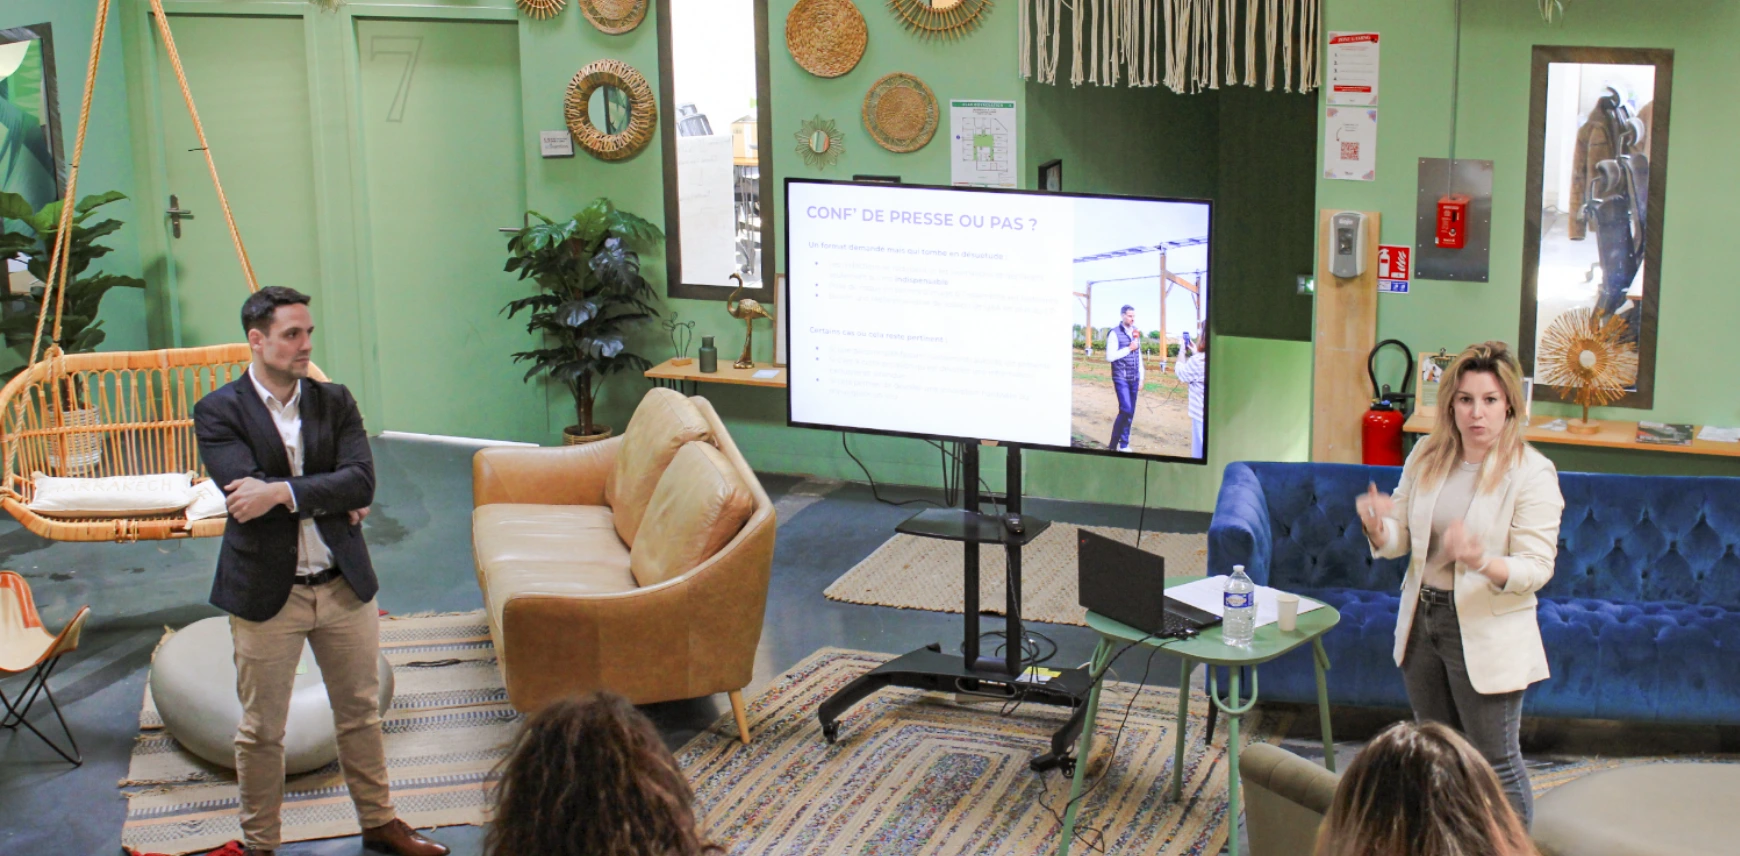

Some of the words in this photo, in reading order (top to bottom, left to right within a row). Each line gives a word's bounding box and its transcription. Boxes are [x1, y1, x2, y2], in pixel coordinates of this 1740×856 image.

[371, 35, 424, 123] 7
[862, 209, 884, 222] DE
[890, 210, 954, 226] PRESSE
[959, 214, 984, 228] OU
[990, 216, 1024, 231] PAS
[1028, 218, 1038, 231] ?
[808, 241, 819, 249] Un
[821, 242, 847, 250] format
[887, 246, 905, 254] mais
[907, 247, 920, 256] qui
[921, 248, 947, 257] tombe
[809, 326, 840, 336] Certains
[842, 329, 855, 337] cas
[868, 331, 884, 339] cela
[907, 334, 944, 343] pertinent
